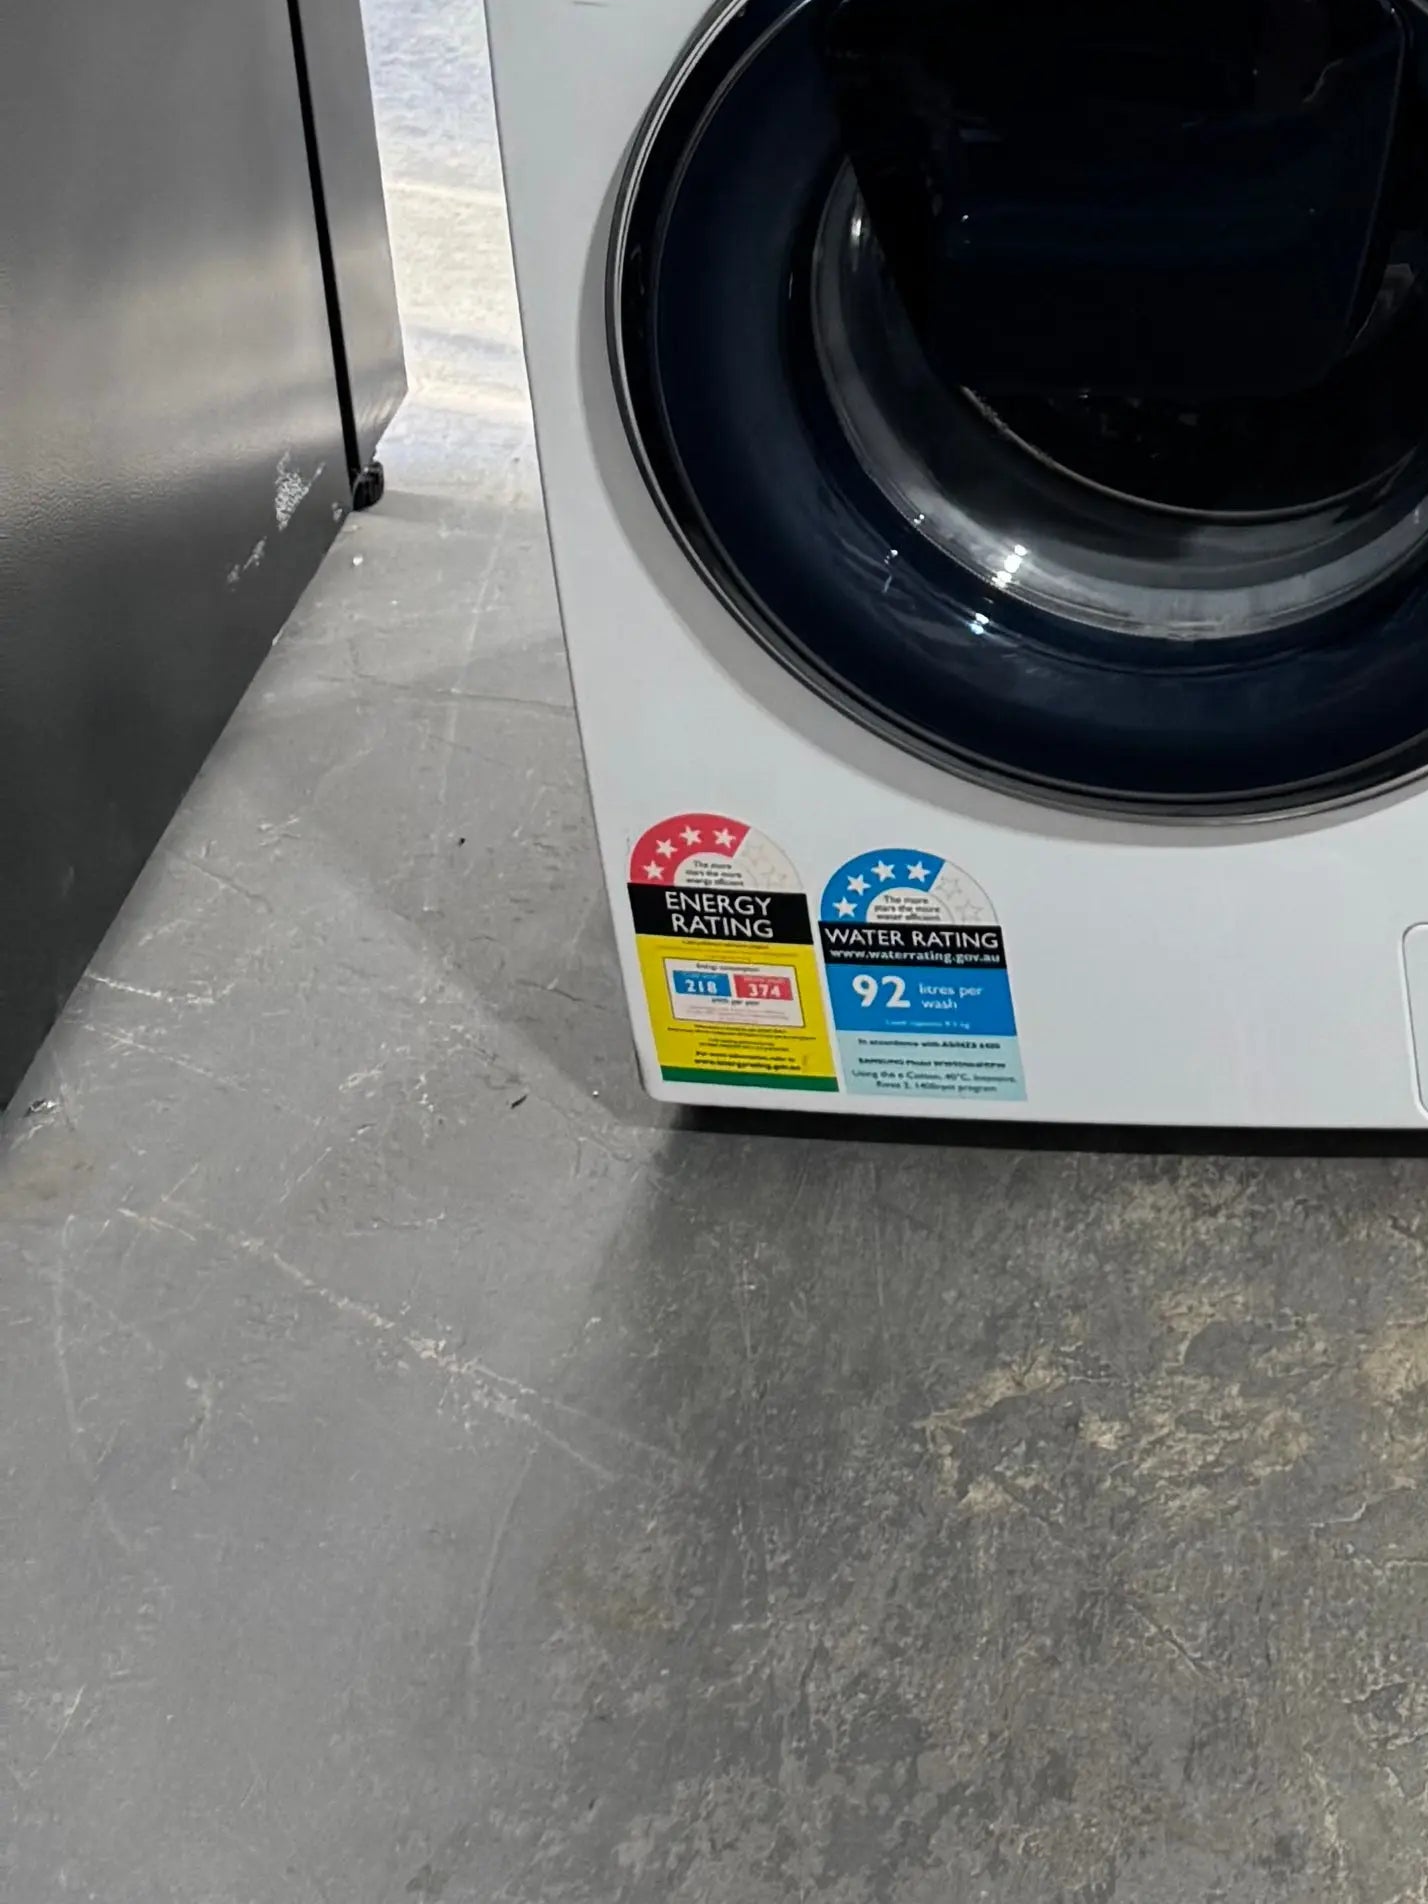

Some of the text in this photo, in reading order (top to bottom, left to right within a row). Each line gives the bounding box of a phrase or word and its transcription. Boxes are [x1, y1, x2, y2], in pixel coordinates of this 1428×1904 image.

[665, 891, 772, 916] ENERGY
[671, 913, 774, 938] RATING
[824, 927, 999, 949] WATER RATING
[829, 948, 1000, 964] www.waterrating.gov.au
[684, 979, 718, 994] 218
[748, 983, 781, 997] 374
[852, 974, 984, 1008] 92 litres per
[921, 998, 958, 1010] wash
